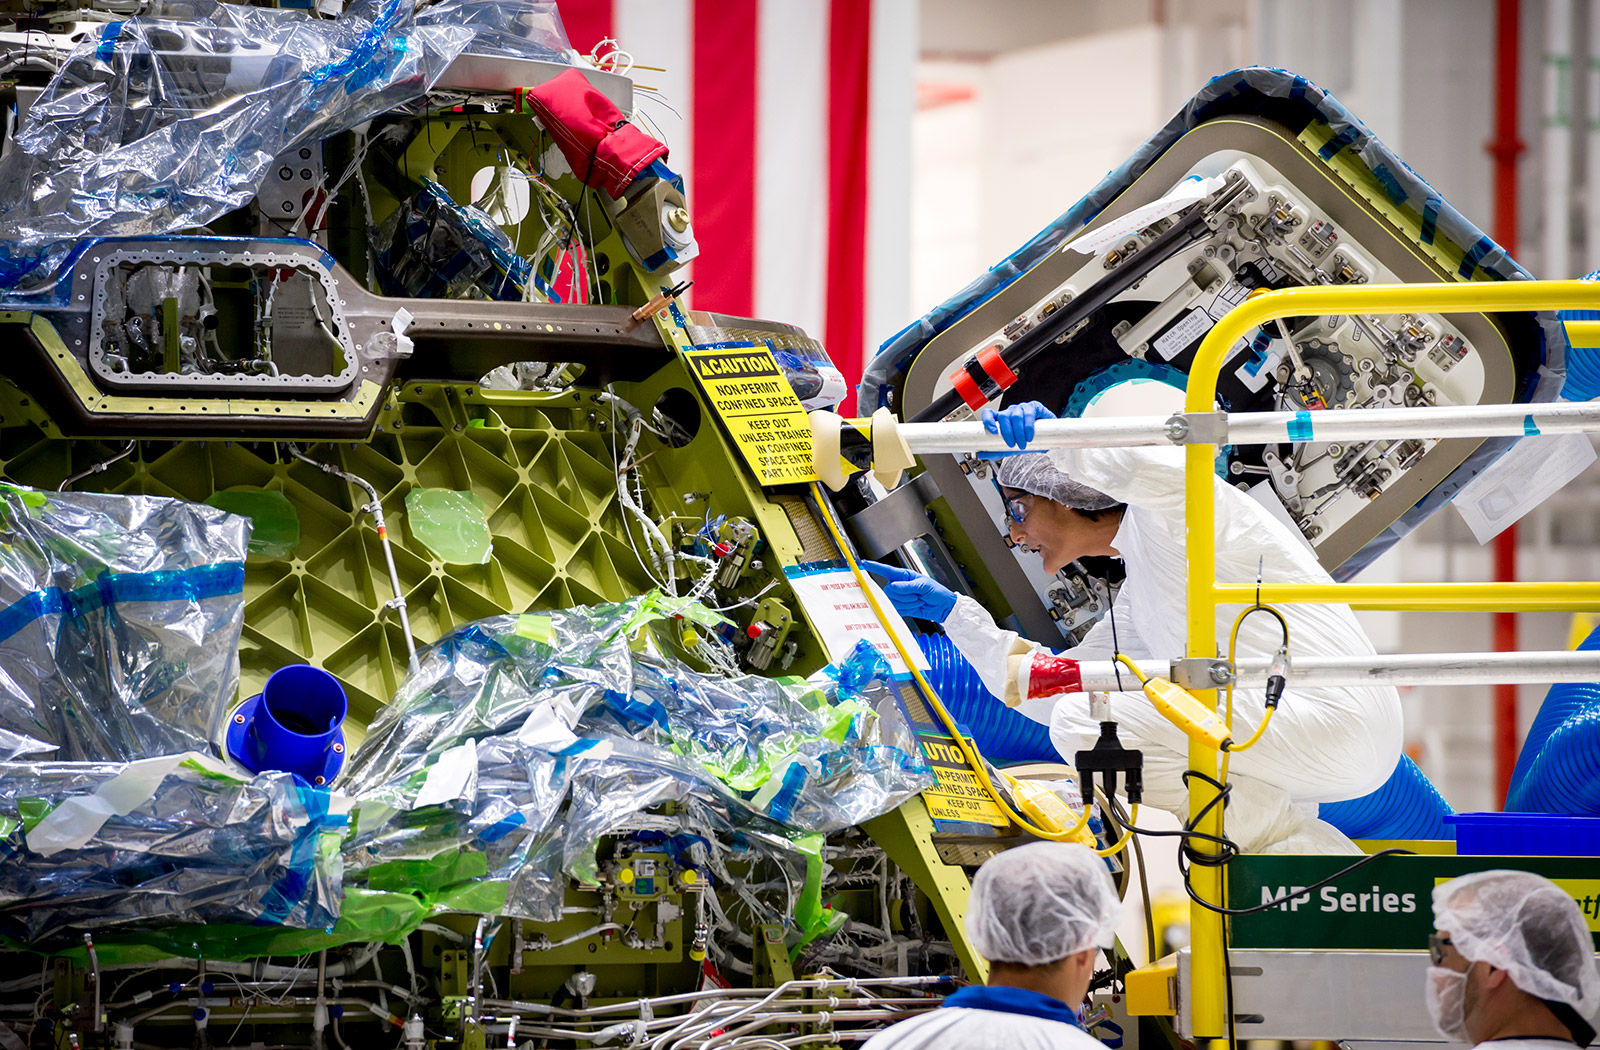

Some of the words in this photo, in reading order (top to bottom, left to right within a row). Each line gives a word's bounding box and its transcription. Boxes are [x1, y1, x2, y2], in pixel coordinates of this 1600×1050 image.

[1161, 331, 1176, 343] Hatch
[1177, 314, 1197, 331] Opening
[708, 356, 774, 375] CAUTION
[716, 382, 782, 396] NON-PERMIT
[717, 399, 766, 411] CONFINED
[767, 396, 798, 408] SPACE
[748, 420, 771, 430] KEEP
[772, 418, 791, 428] OUT
[739, 432, 775, 443] UNLESS
[776, 429, 812, 440] TRAINED
[755, 445, 766, 454] IN
[768, 442, 812, 453] CONFINED
[758, 455, 788, 466] SPACE
[761, 468, 785, 478] PART
[786, 467, 792, 476] 1
[931, 769, 978, 784] ON-PERMIT
[924, 782, 965, 796] ONFINED
[946, 799, 964, 808] KEEP
[966, 801, 981, 810] OUT
[931, 808, 960, 818] UNLESS
[1261, 886, 1310, 912] MP
[1320, 885, 1417, 913] Series
